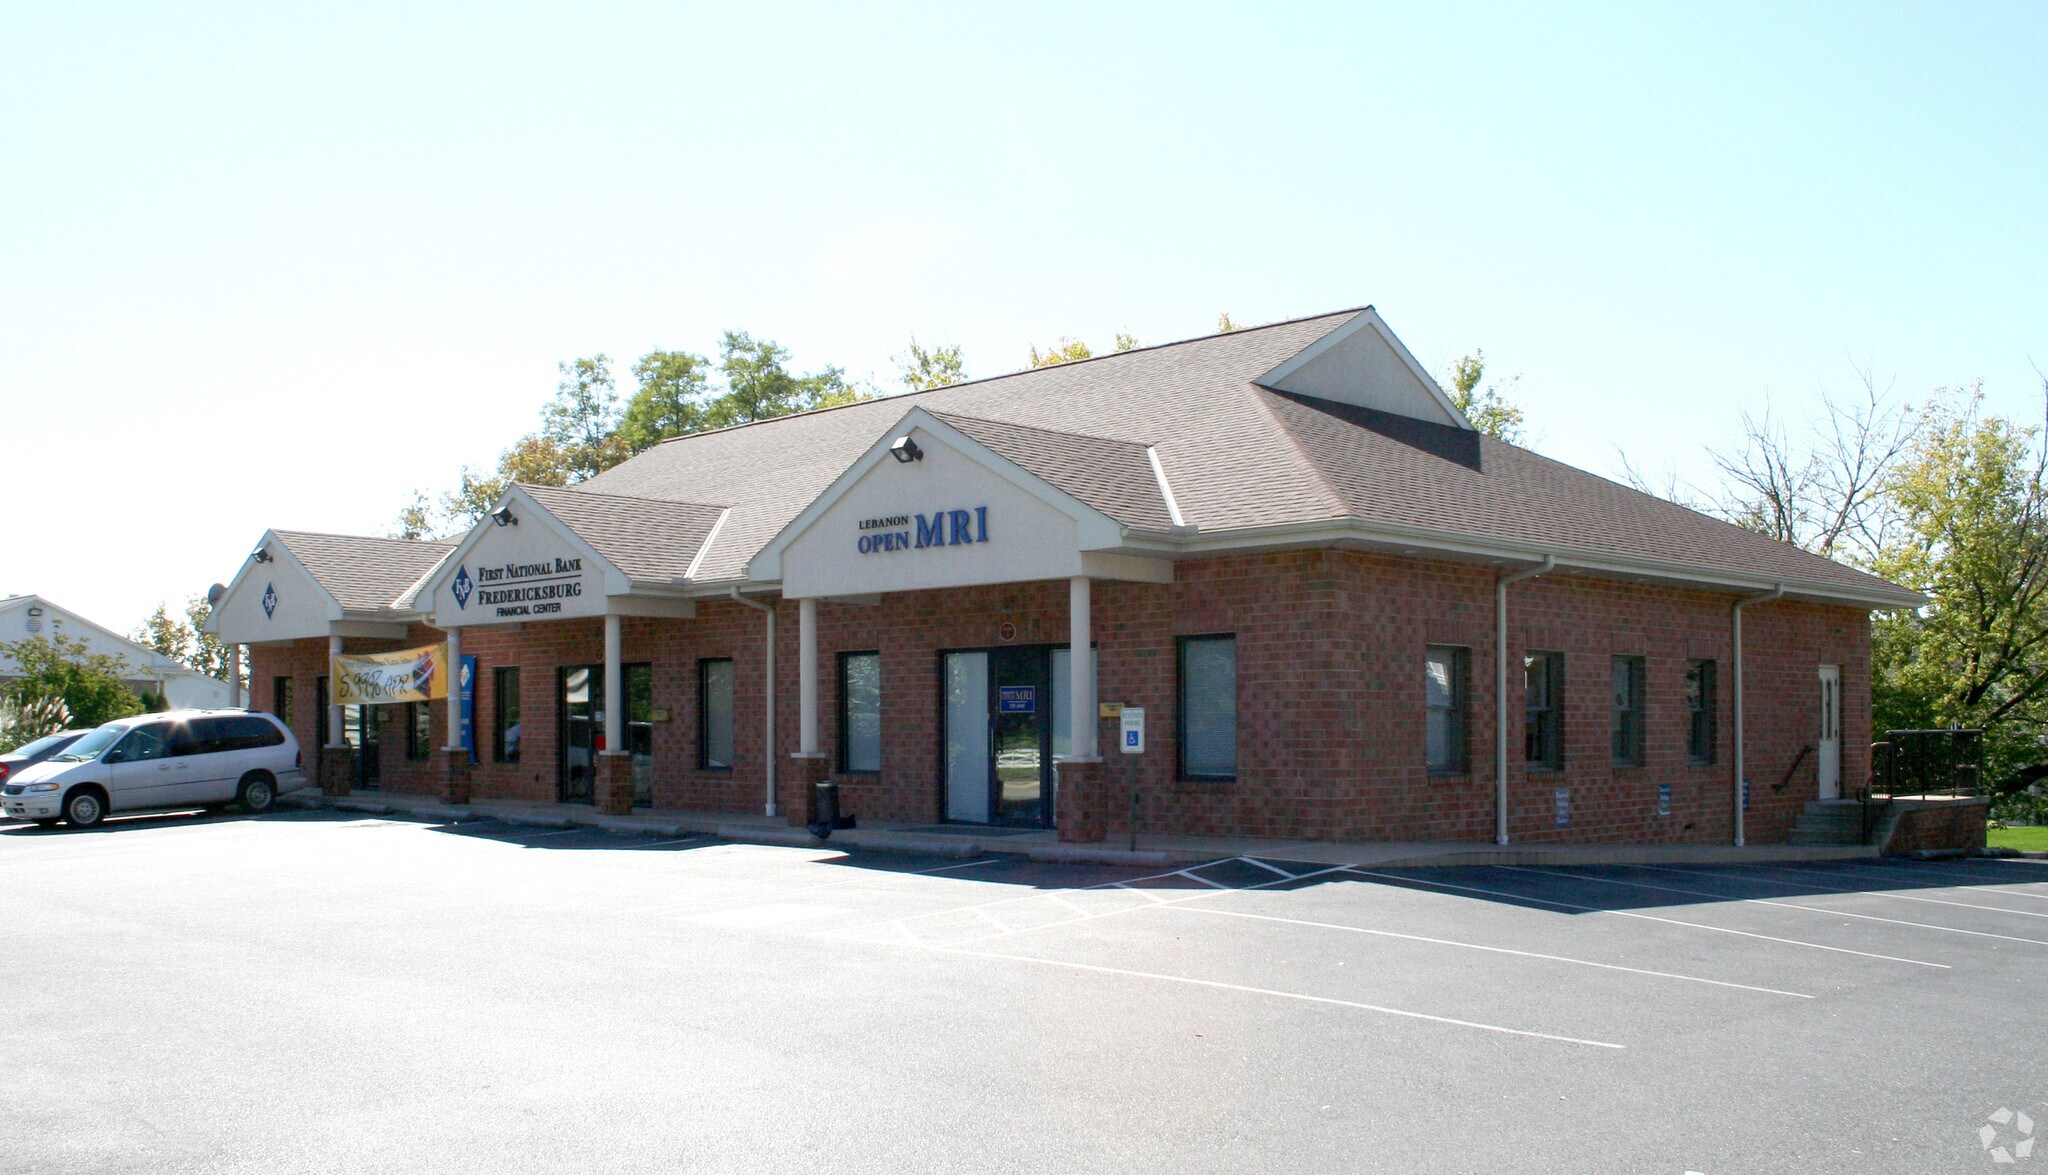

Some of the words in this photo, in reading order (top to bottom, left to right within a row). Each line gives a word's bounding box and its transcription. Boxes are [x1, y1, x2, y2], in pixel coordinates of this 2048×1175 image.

[857, 531, 910, 554] OPEN
[914, 506, 989, 549] MRI
[859, 515, 909, 530] LEBANON
[479, 567, 504, 581] FIRST
[507, 563, 552, 578] NATIONAL
[556, 558, 582, 573] BANK
[479, 583, 581, 604] FREDERICKSBURG
[497, 606, 530, 616] FINANCIAL
[533, 603, 562, 613] CENTER
[383, 674, 409, 697] APR
